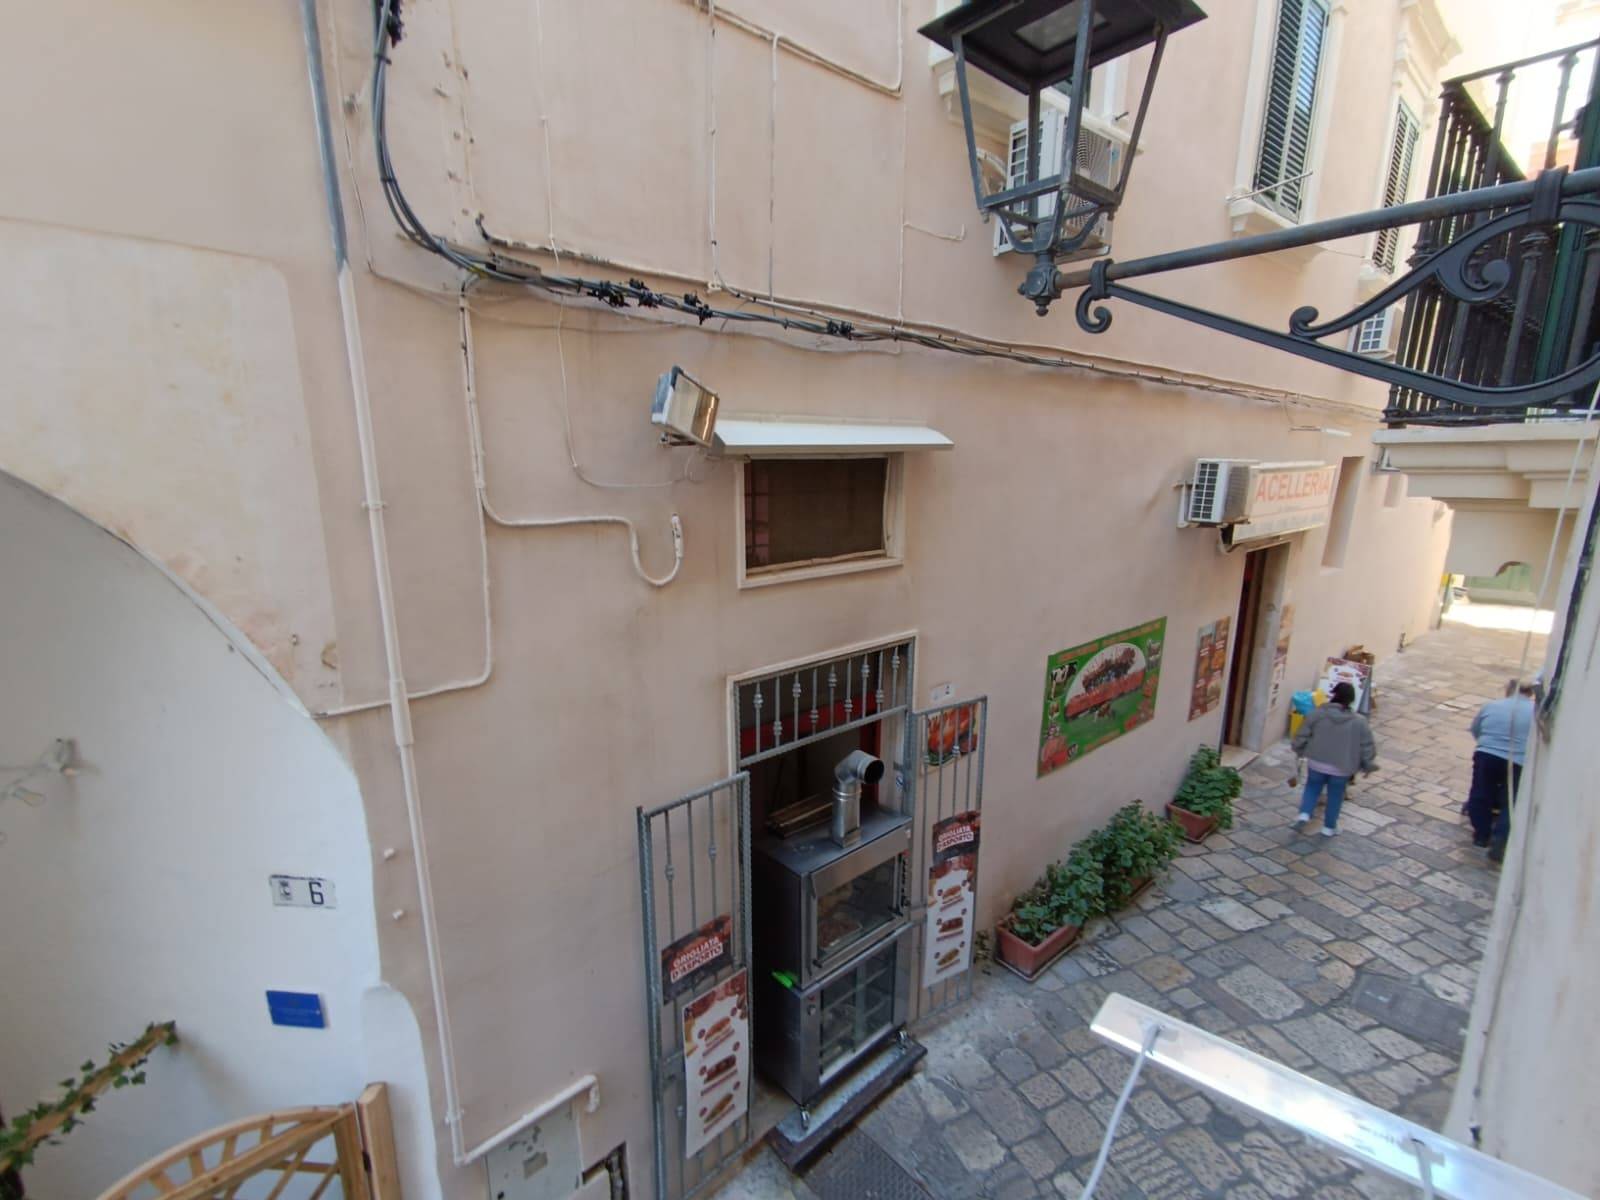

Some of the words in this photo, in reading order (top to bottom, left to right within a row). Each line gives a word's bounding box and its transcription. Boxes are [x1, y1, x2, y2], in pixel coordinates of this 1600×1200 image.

[1255, 471, 1330, 502] ACELLERIA
[308, 881, 324, 905] 6
[671, 944, 722, 980] D'ASPORTO
[673, 935, 720, 968] GRIGLIATA
